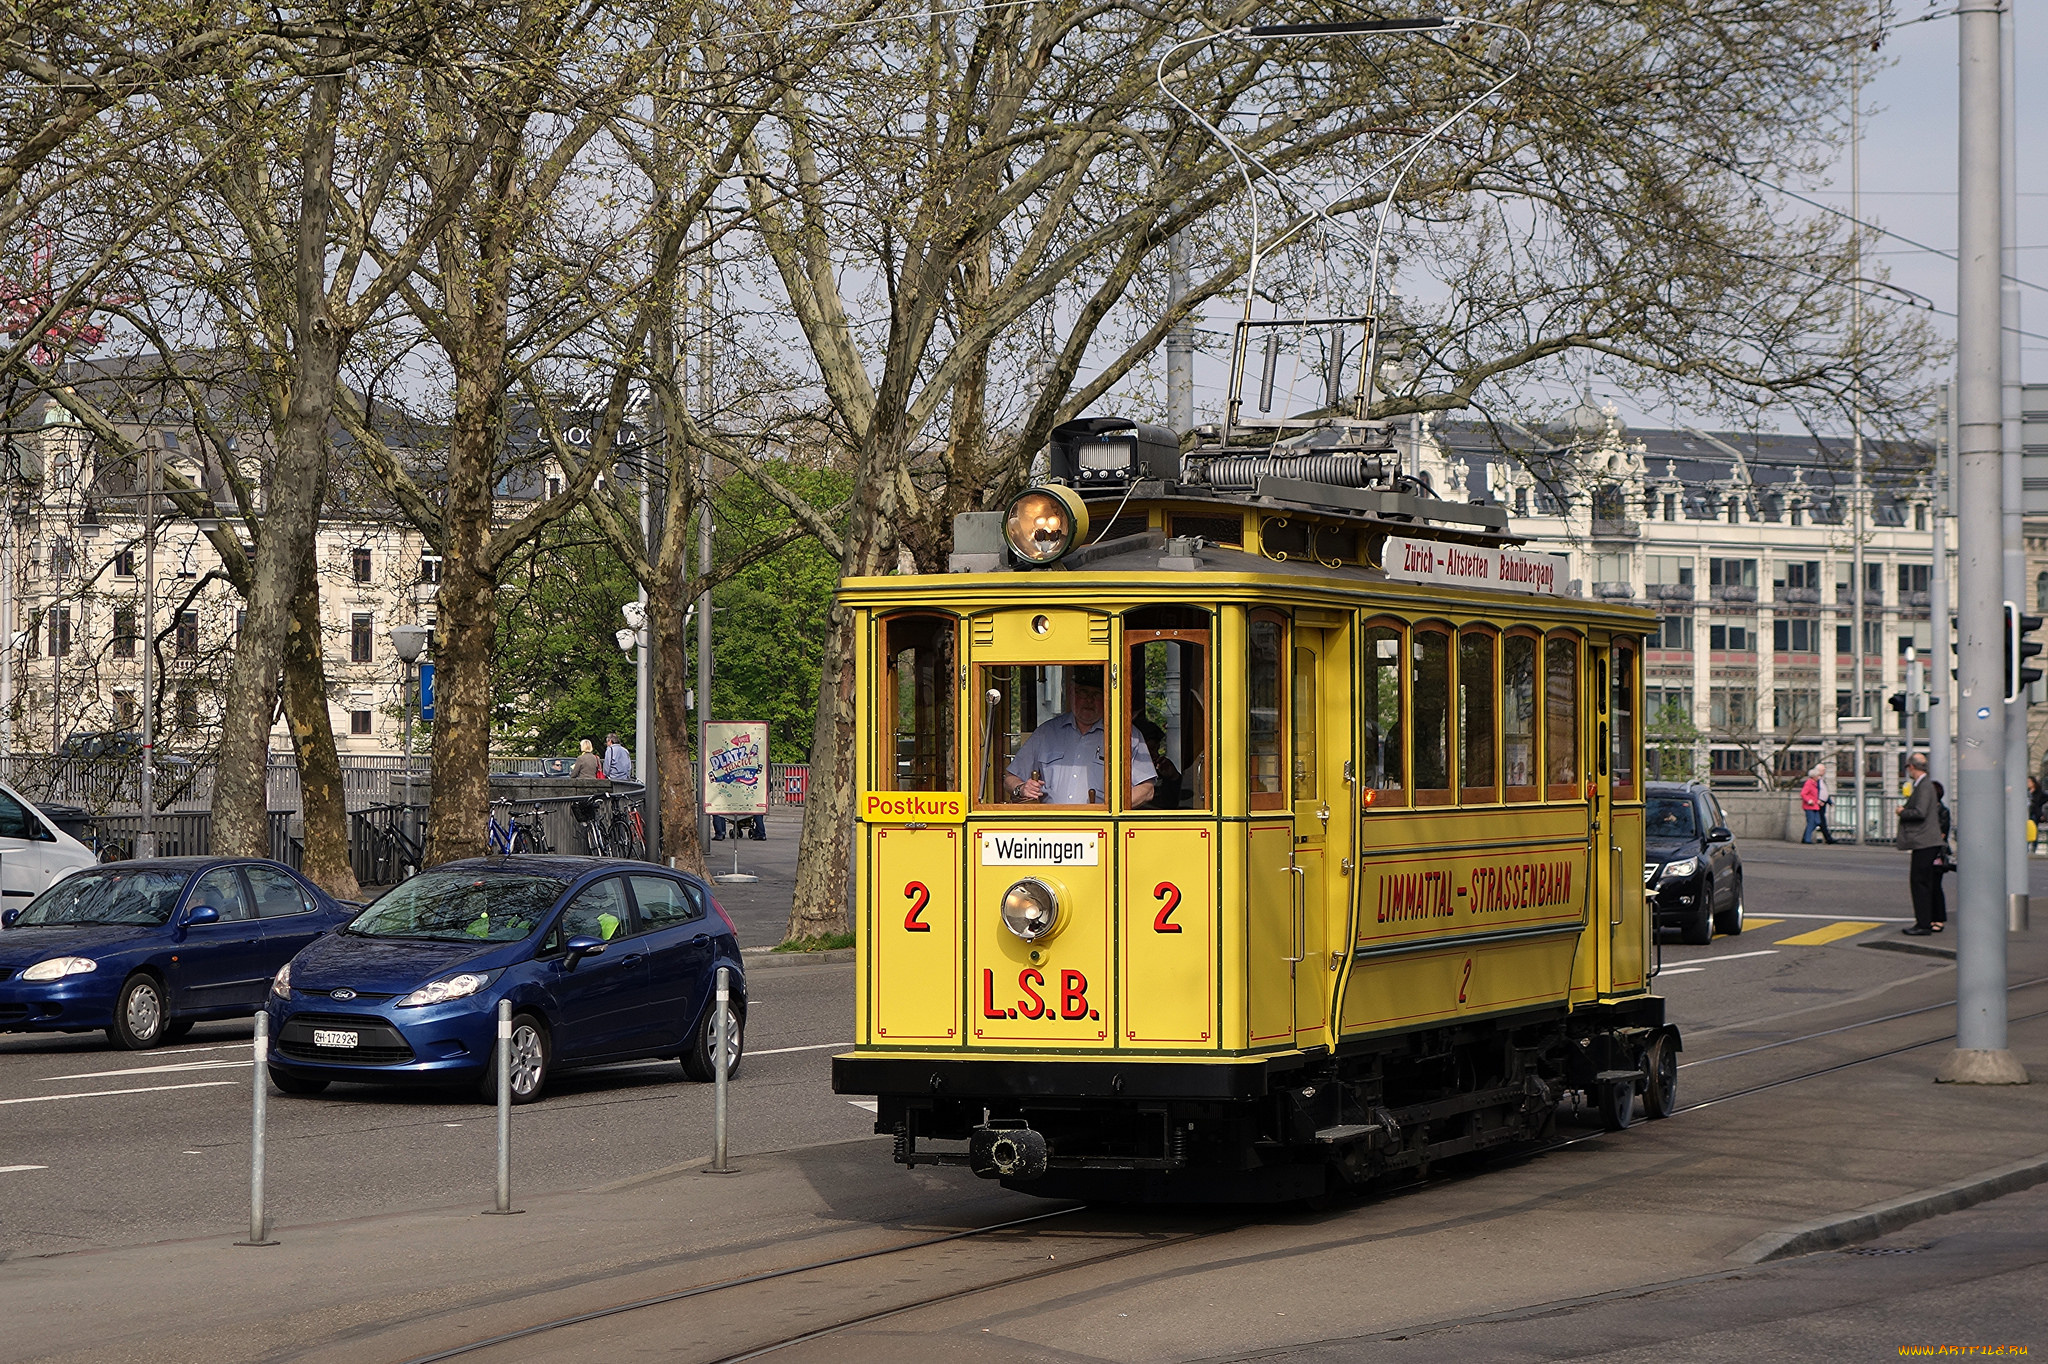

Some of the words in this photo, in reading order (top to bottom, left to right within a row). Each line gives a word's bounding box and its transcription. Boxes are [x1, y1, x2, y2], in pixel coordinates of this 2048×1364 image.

[1404, 543, 1434, 574] Zürich
[1446, 548, 1489, 579] Altstetten
[1500, 553, 1554, 593] Bahnübergang
[867, 796, 960, 815] Postkurs
[995, 837, 1083, 864] Weiningen
[903, 880, 931, 932] 2
[1153, 881, 1183, 933] 2
[1377, 870, 1454, 923] LIMMATTAL
[1470, 860, 1572, 914] STRASSENBAHN
[983, 968, 1100, 1021] L.S.B.
[1458, 958, 1472, 1003] 2
